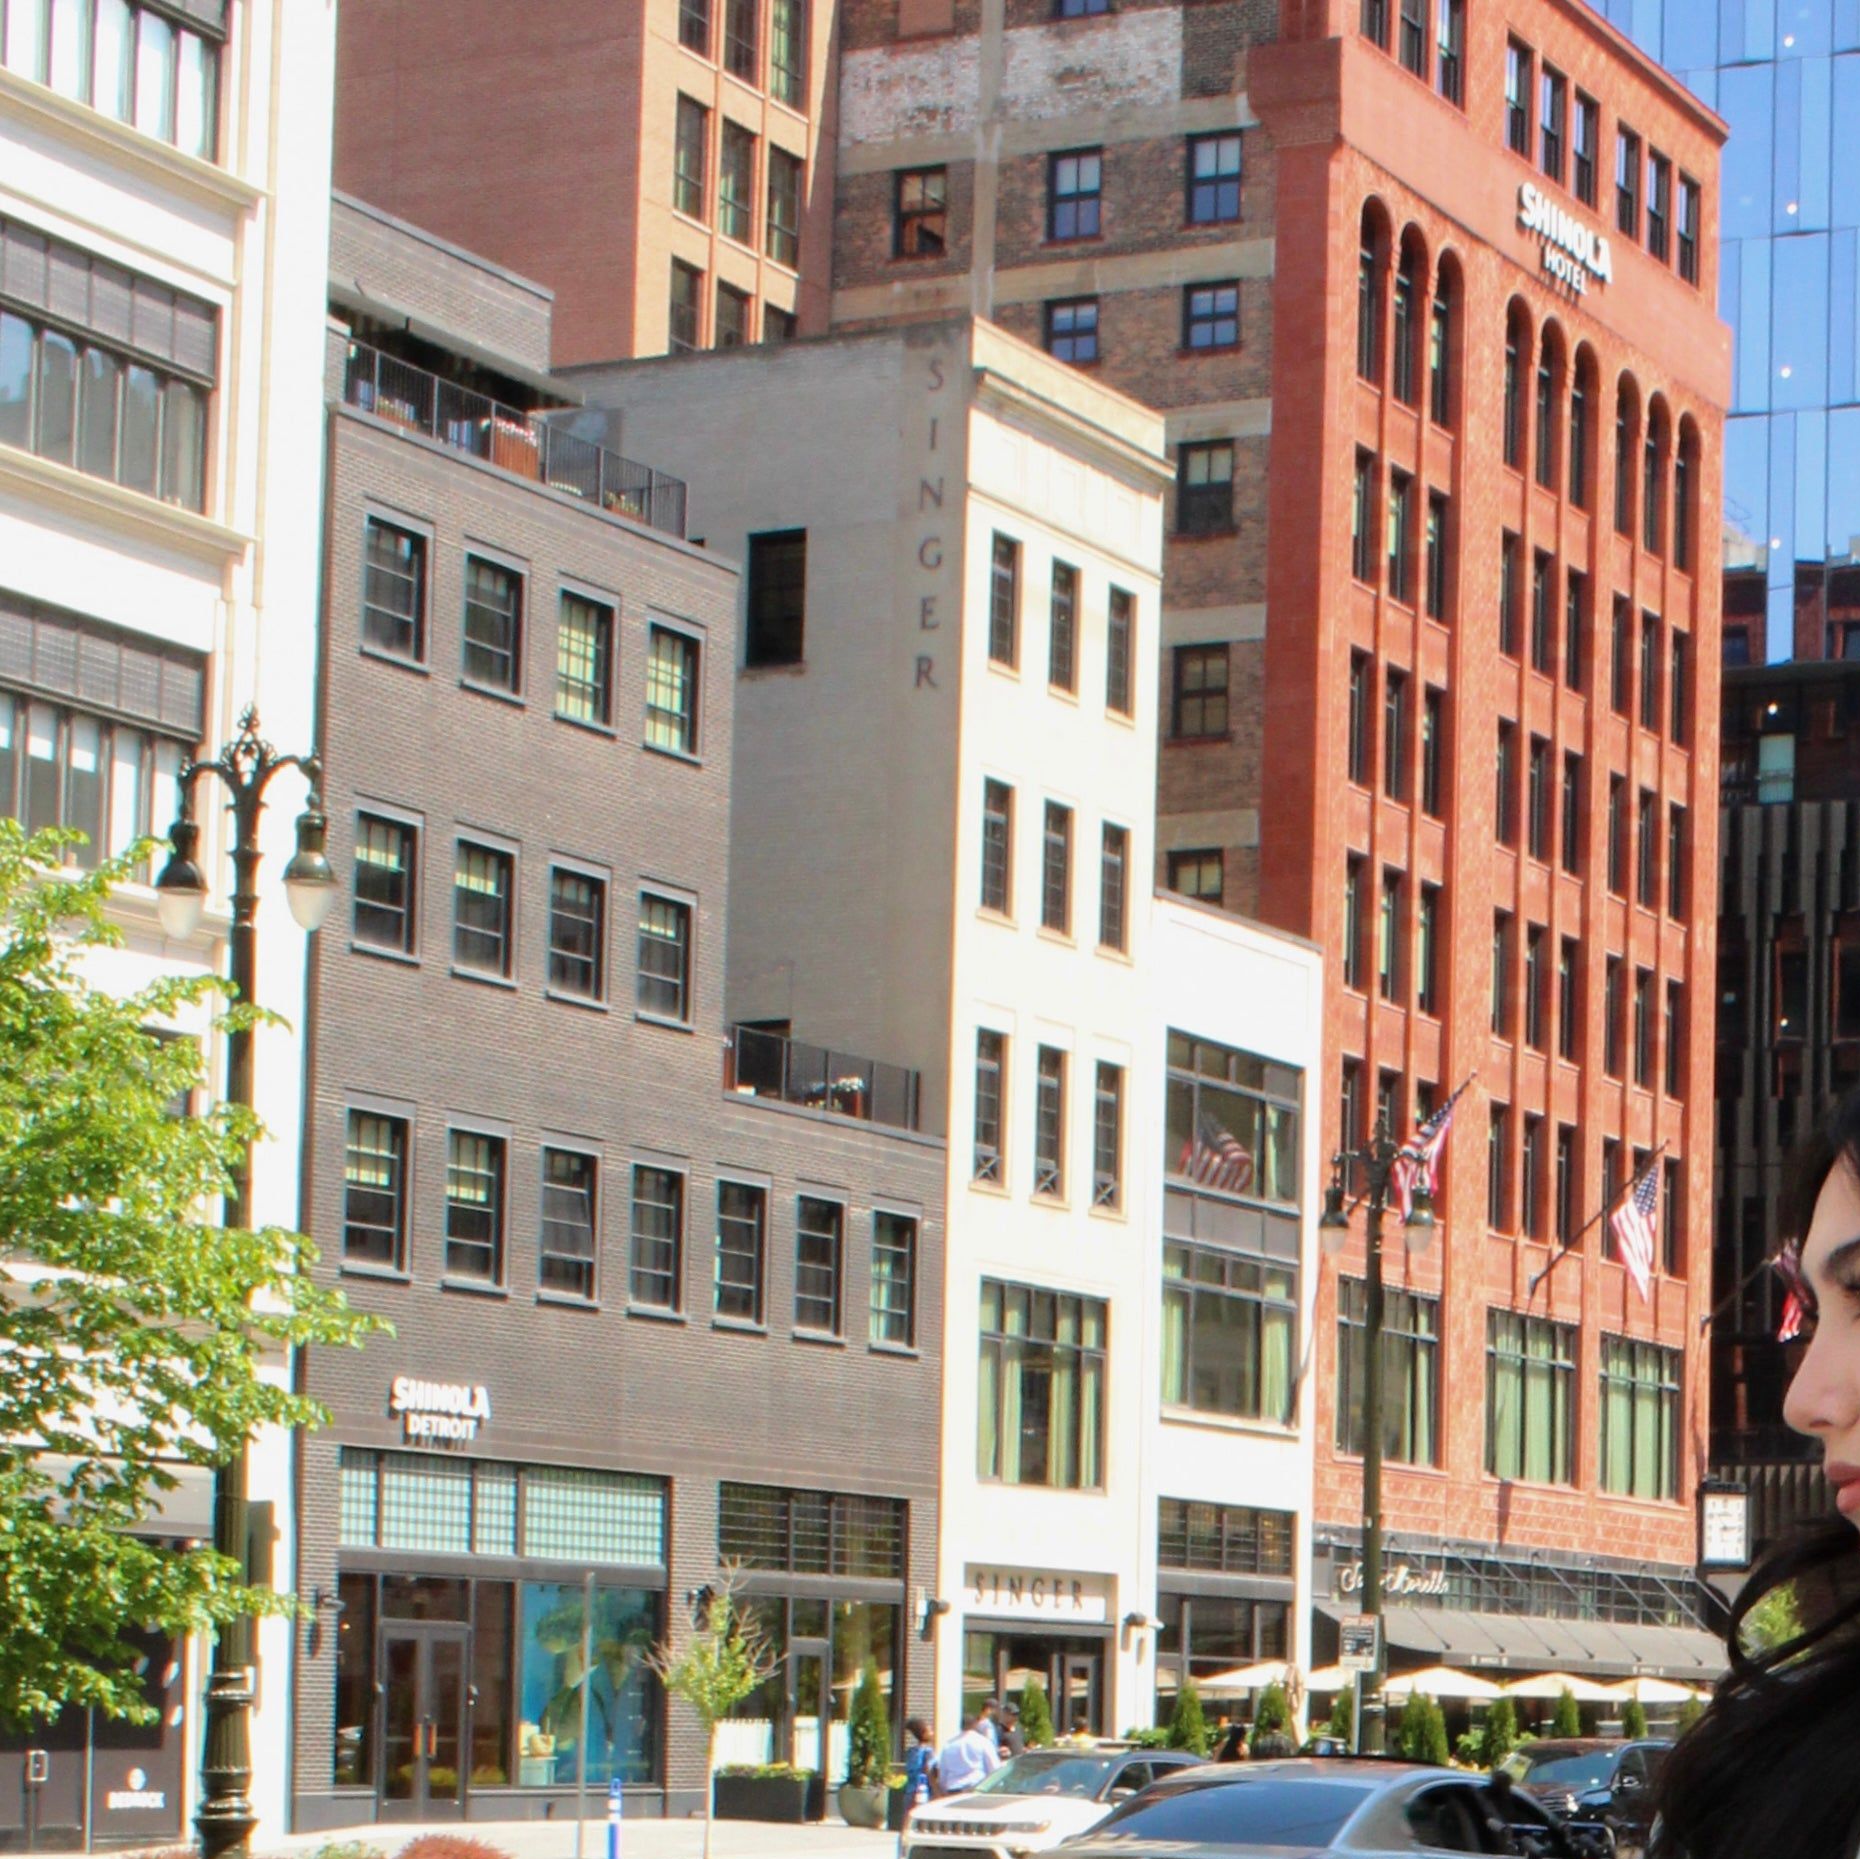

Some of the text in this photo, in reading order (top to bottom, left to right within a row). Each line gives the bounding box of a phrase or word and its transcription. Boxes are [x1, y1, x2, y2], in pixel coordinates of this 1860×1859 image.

[1519, 181, 1614, 285] SHINOLA
[1544, 244, 1588, 296] HOTEL
[914, 358, 945, 689] SINGER
[391, 1375, 492, 1420] SHINOLA
[405, 1411, 478, 1441] DETROIT
[974, 1570, 1083, 1611] SINGER
